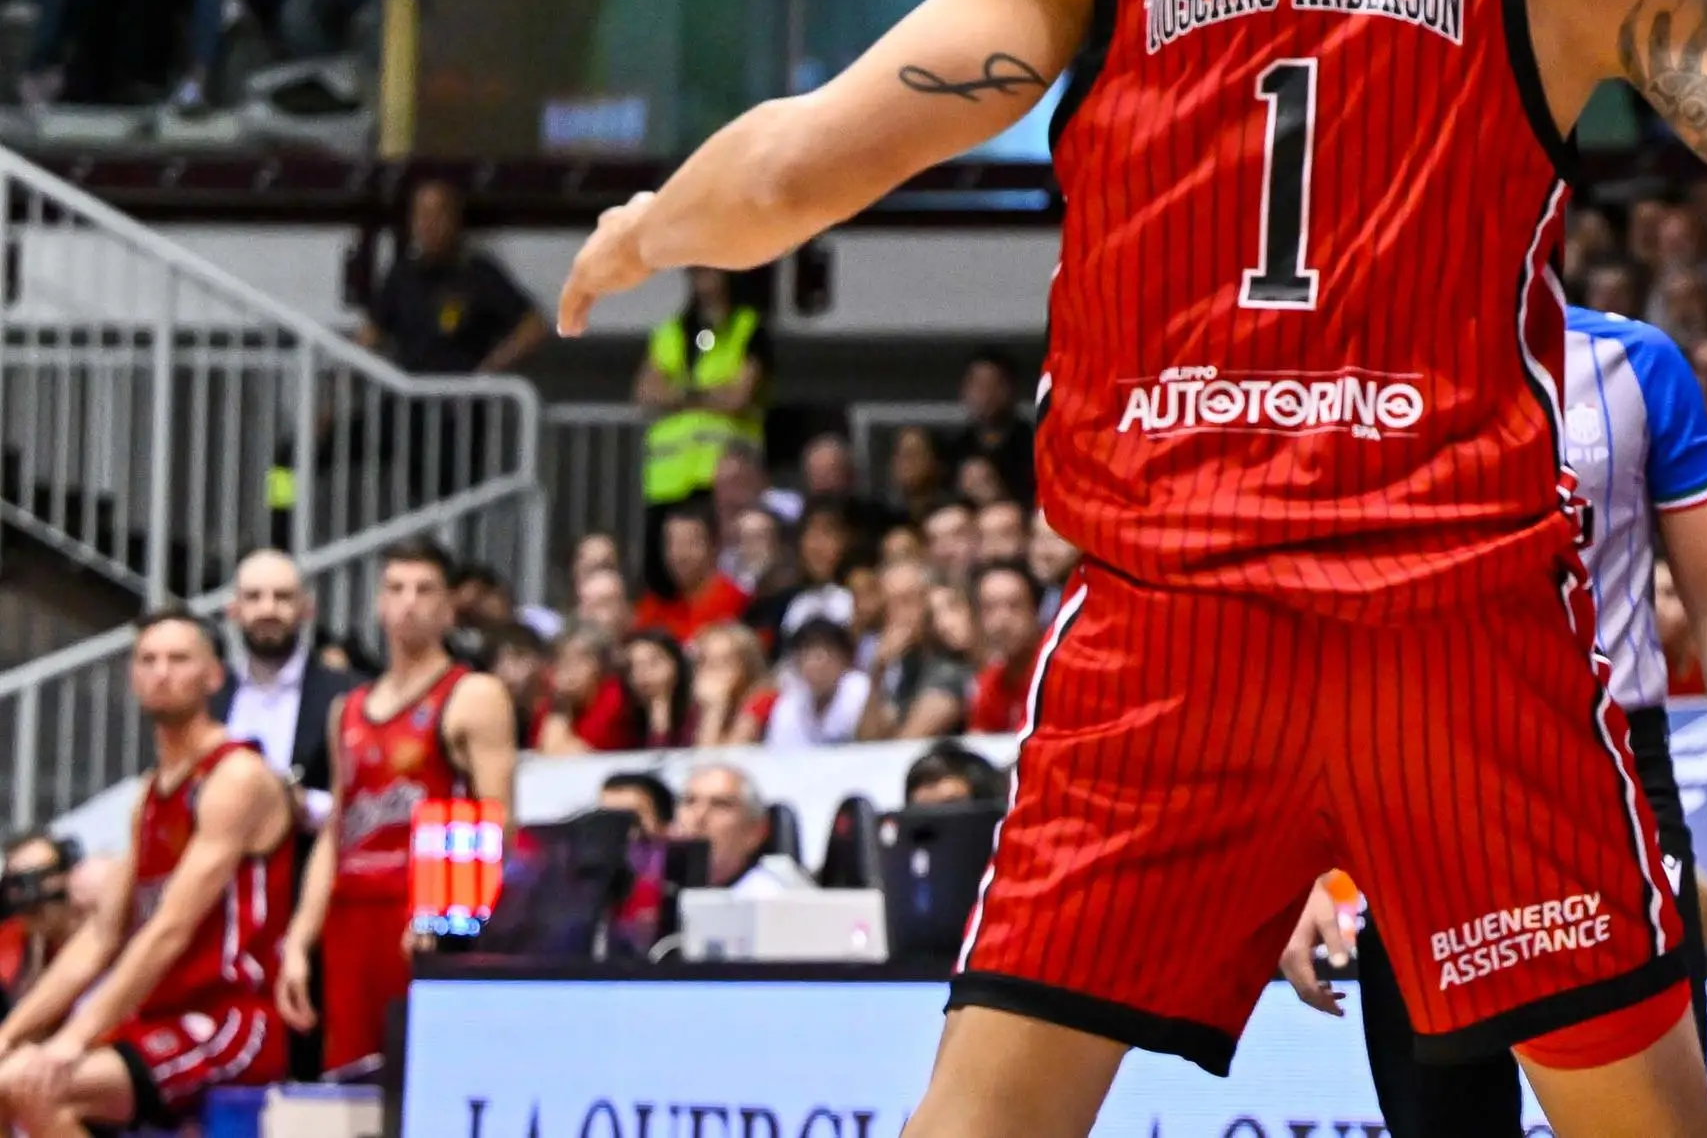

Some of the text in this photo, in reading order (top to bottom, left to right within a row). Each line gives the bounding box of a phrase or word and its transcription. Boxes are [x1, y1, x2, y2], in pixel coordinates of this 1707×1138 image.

[1239, 57, 1319, 311] 1
[1117, 377, 1424, 433] AUTOTORINO
[1431, 891, 1602, 962] BLUENERGY
[1439, 915, 1612, 991] ASSISTANCE
